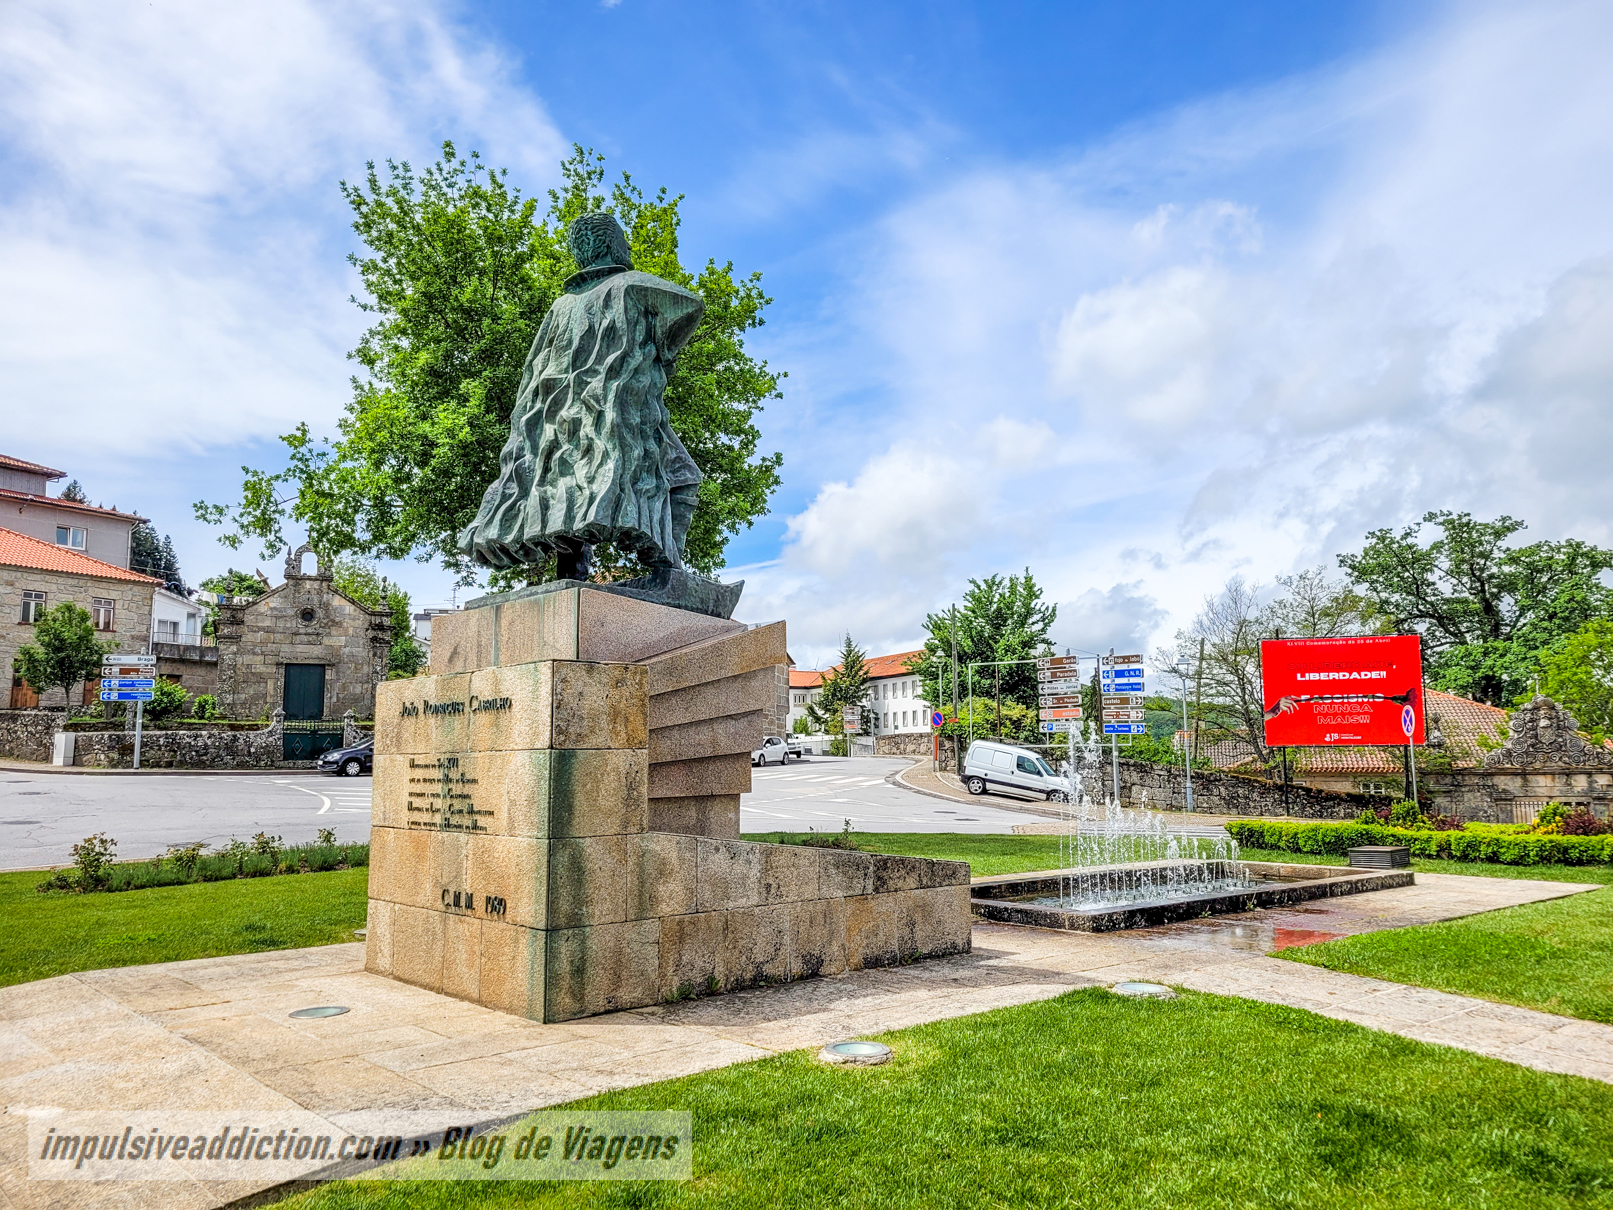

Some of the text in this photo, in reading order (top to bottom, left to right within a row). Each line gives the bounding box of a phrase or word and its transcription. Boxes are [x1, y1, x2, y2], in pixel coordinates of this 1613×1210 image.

[1297, 671, 1386, 680] LIBERDADE!!
[1313, 704, 1374, 714] NUNCA
[1316, 715, 1371, 725] MAIS!!!
[485, 894, 507, 915] 1989
